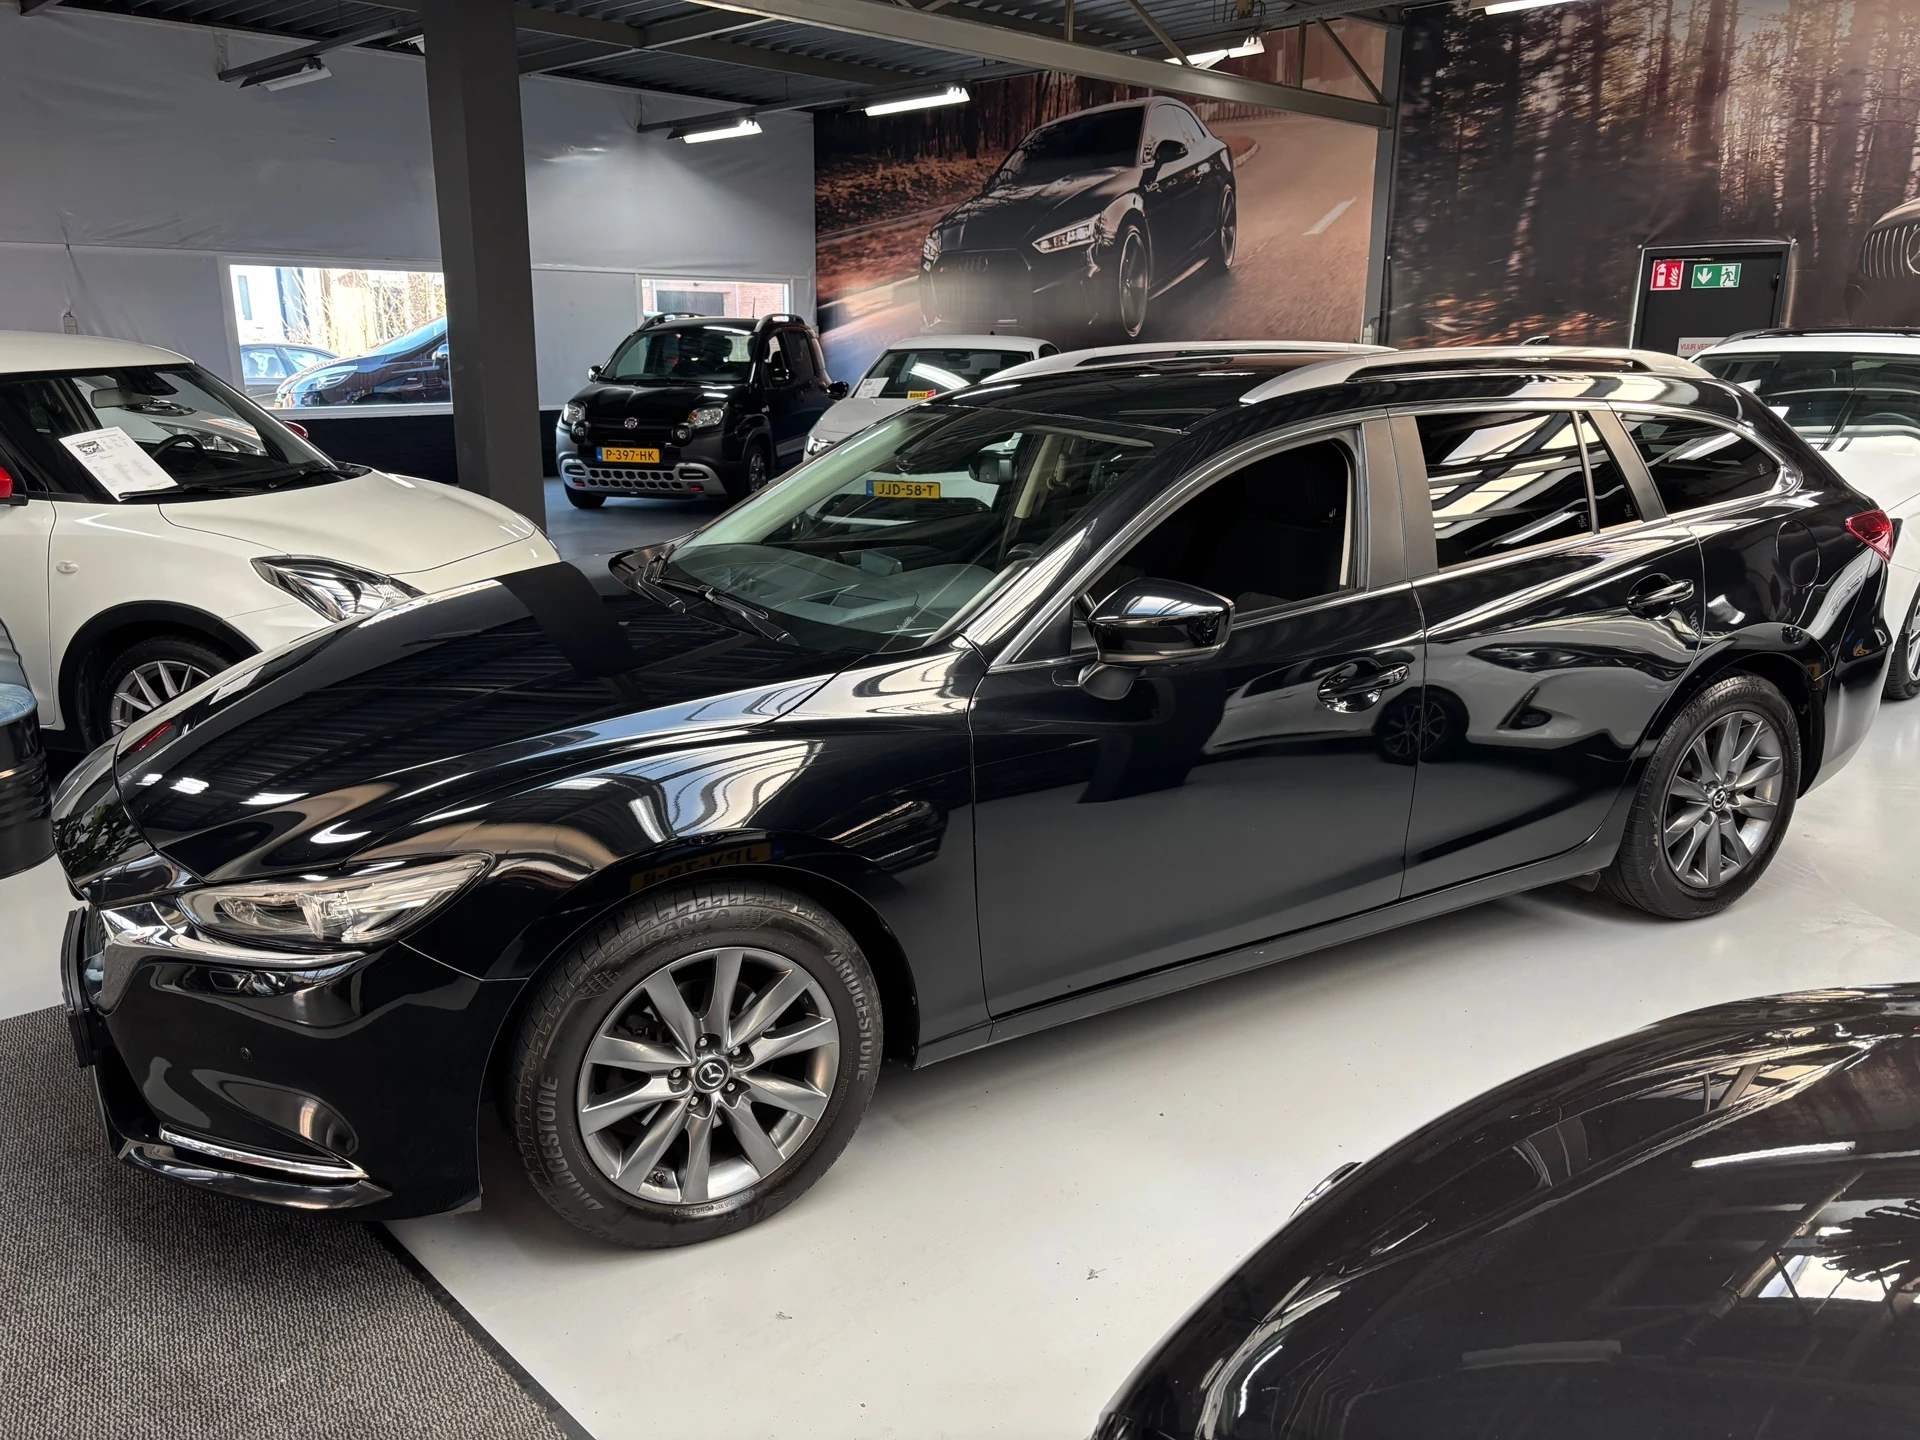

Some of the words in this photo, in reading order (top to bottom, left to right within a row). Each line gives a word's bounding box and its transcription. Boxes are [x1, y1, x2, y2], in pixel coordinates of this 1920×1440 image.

[605, 449, 655, 461] P-397-HK
[879, 483, 934, 496] JJD-58-T
[612, 908, 731, 964] TURANZA
[824, 949, 874, 1081] BRIDGESTONE
[537, 1076, 604, 1210] BRIDGESTONE
